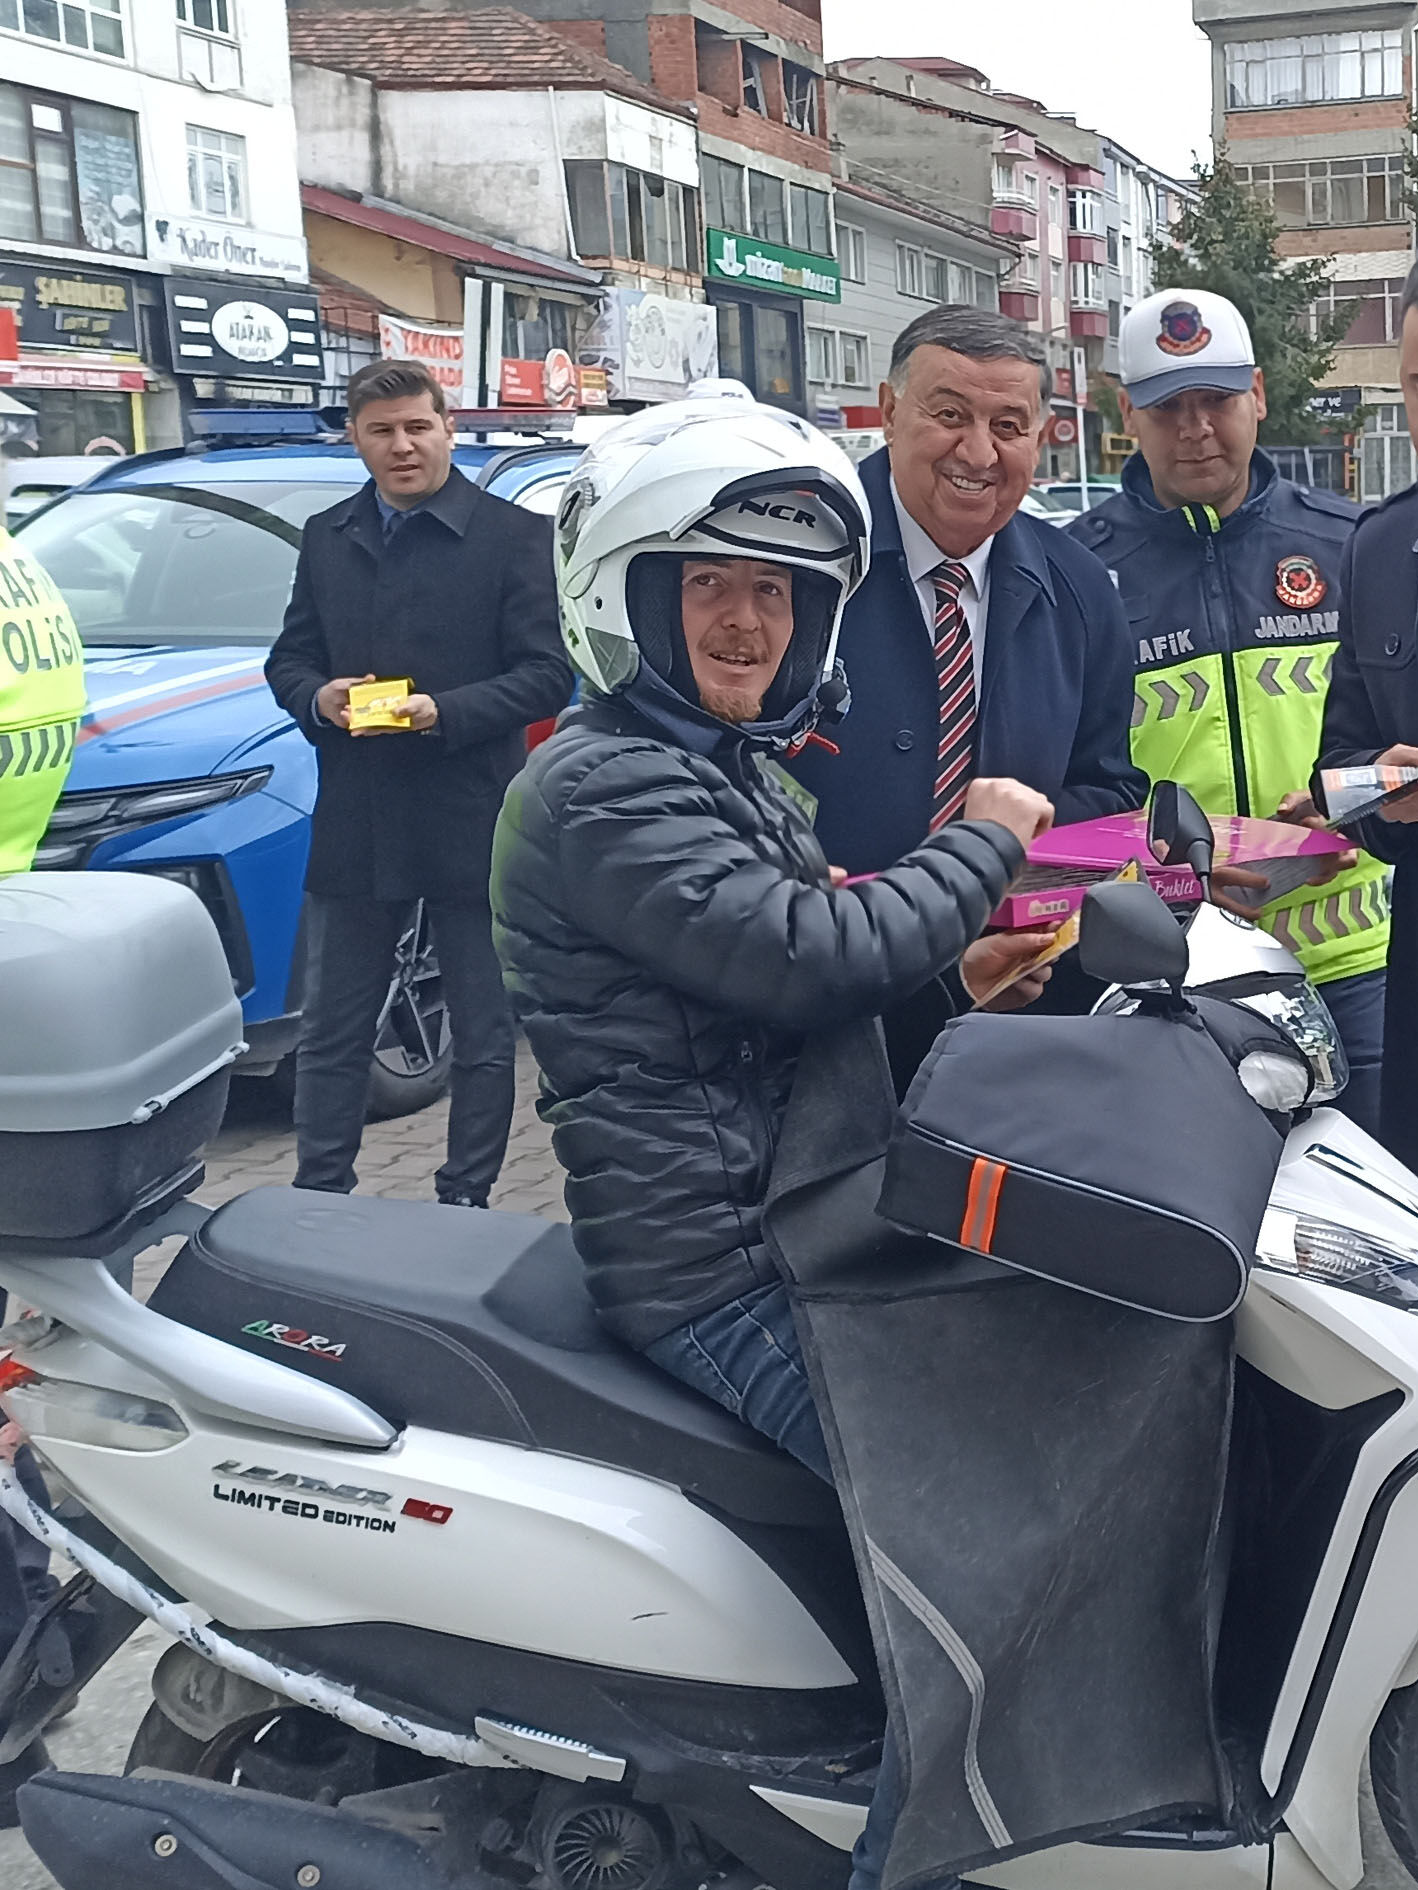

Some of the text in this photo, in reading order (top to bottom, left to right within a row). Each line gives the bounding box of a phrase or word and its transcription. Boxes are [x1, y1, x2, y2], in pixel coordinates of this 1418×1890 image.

[402, 328, 463, 361] YAKIND
[738, 500, 817, 529] NCR
[0, 558, 51, 609] AF
[2, 614, 79, 674] OLİS
[1255, 611, 1340, 639] JANDARM
[1134, 629, 1195, 666] AFİK
[241, 1319, 347, 1358] ARORA
[213, 1484, 397, 1534] LIMITED EDITION
